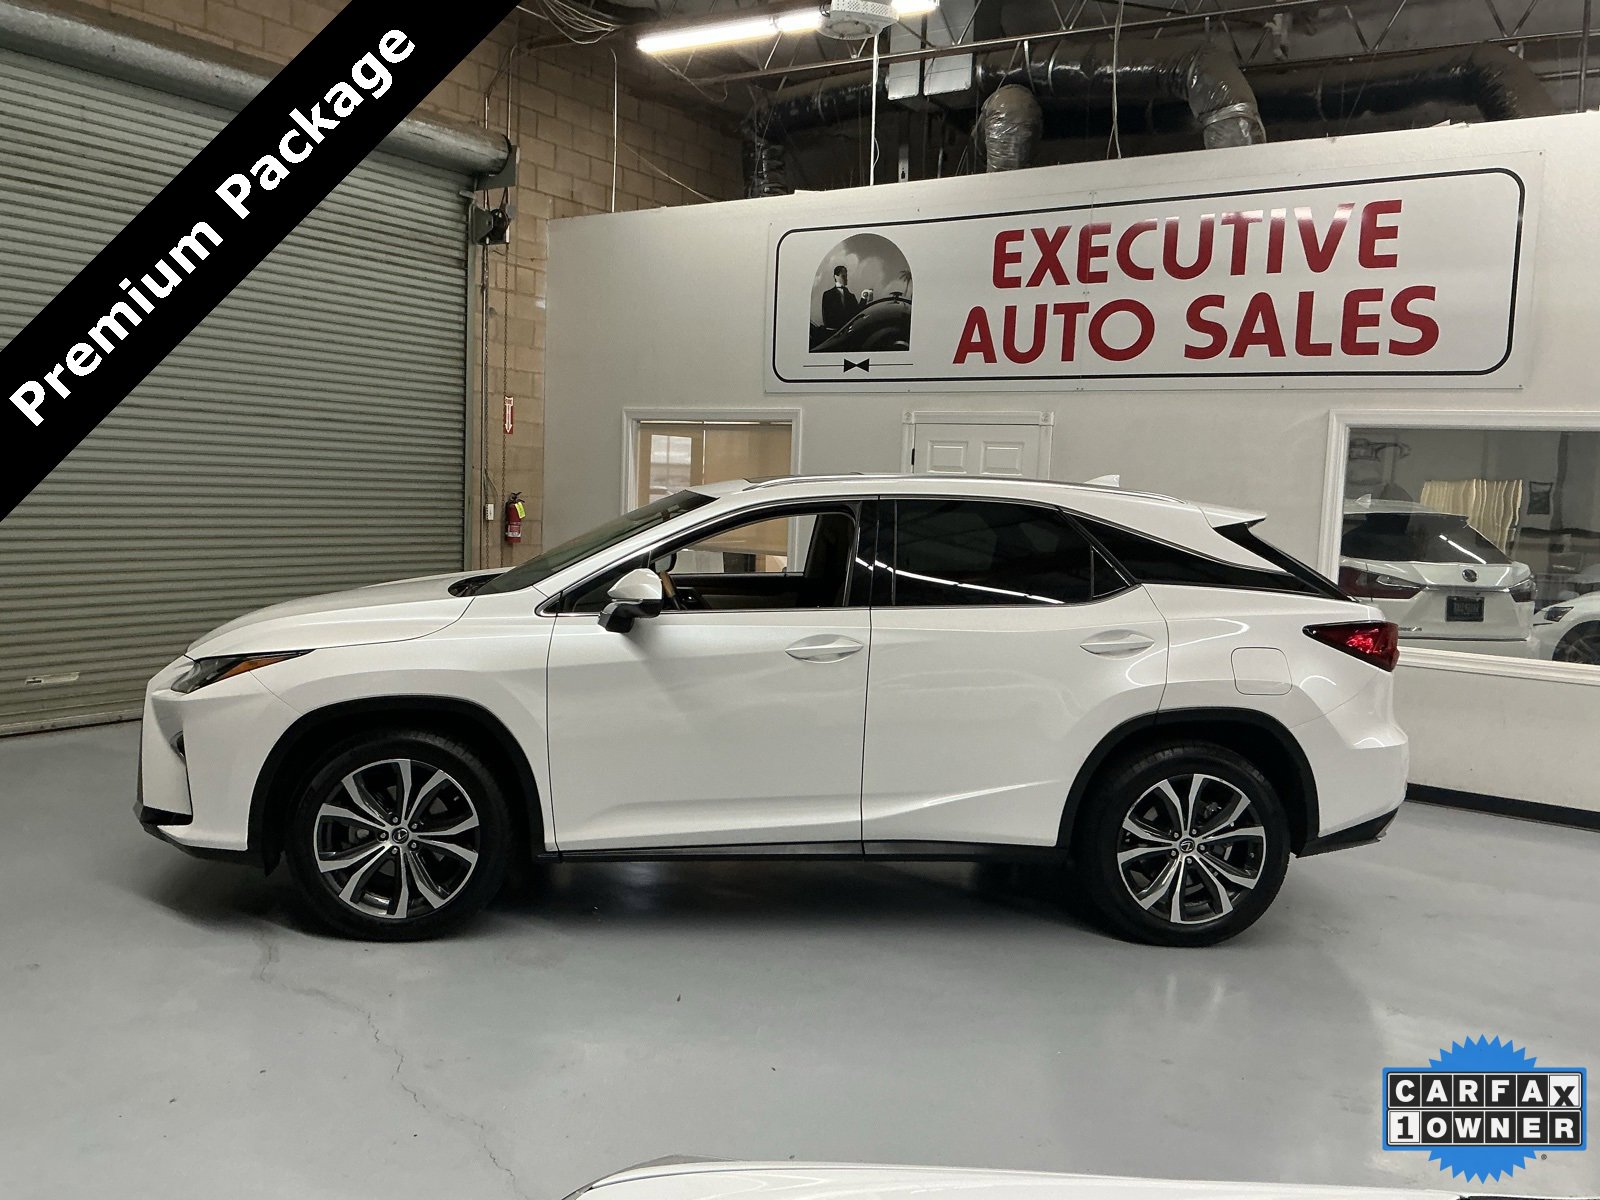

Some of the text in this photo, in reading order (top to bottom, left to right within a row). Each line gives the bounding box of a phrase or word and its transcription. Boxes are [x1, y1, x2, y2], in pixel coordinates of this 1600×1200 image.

[993, 200, 1402, 289] EXECUTIVE
[953, 286, 1440, 364] AUTO SALES
